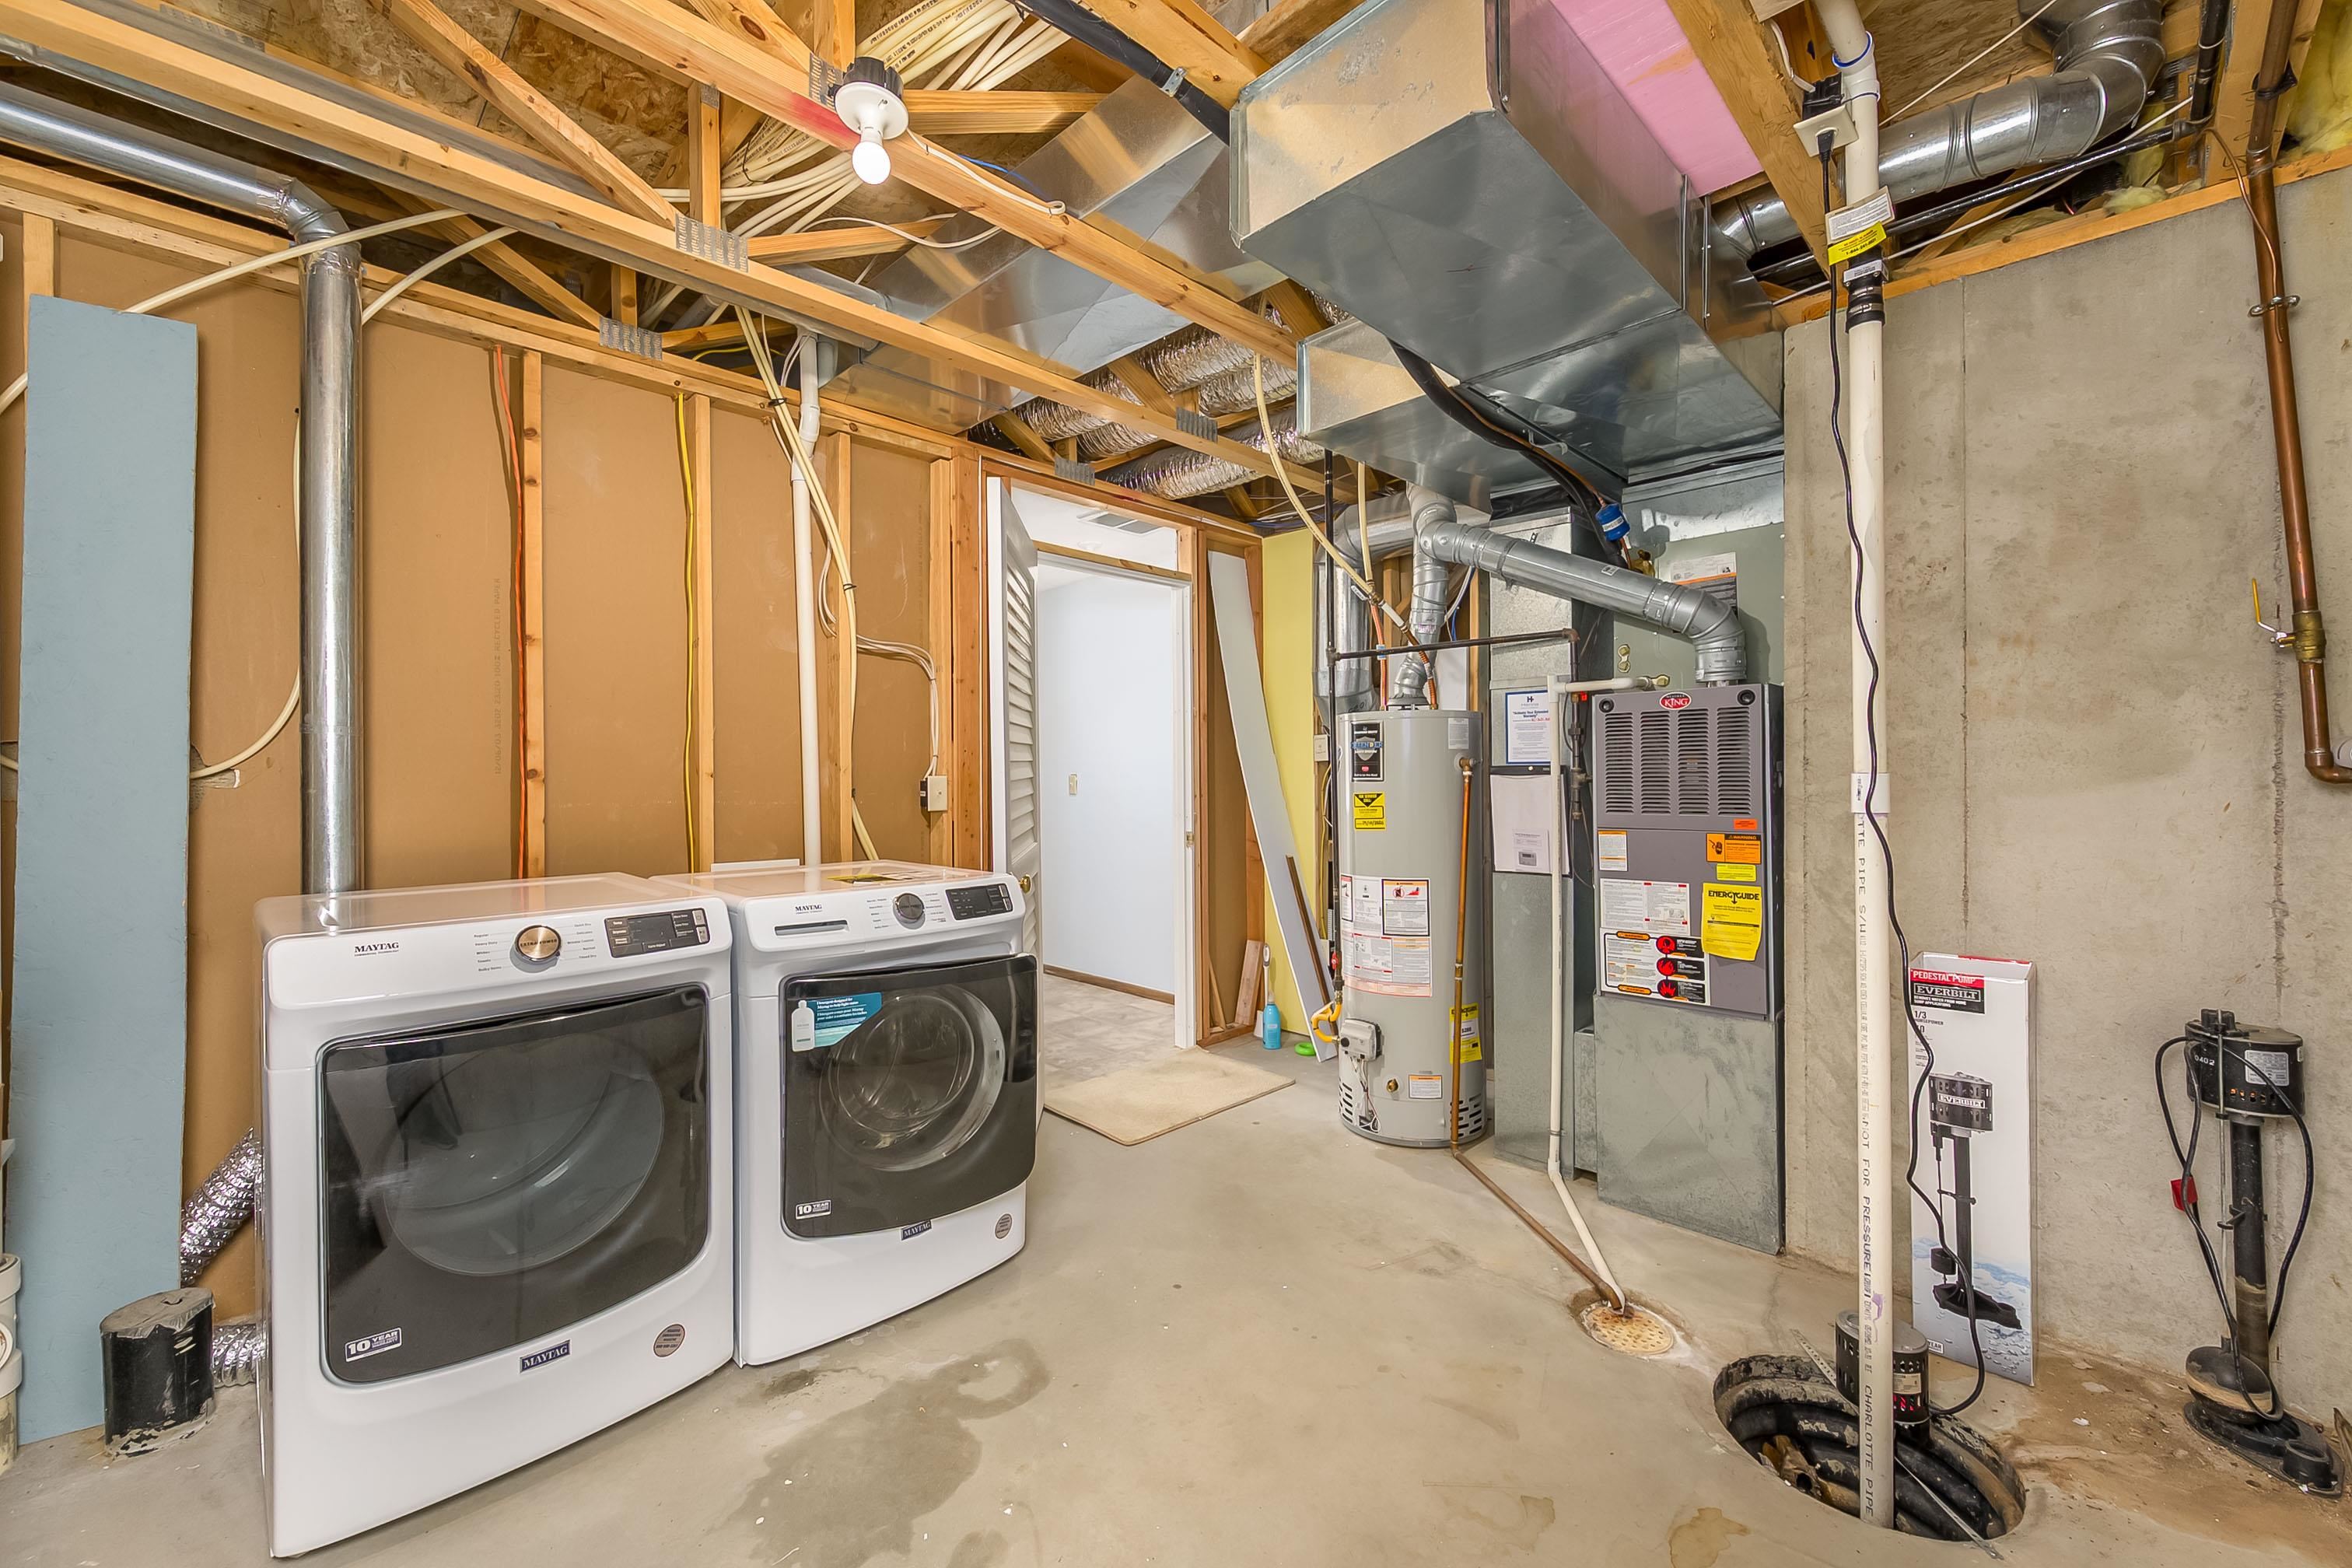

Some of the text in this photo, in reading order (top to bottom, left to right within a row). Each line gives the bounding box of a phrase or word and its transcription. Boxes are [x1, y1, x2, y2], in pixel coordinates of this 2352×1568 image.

[1664, 698, 1689, 708] KING
[1708, 891, 1759, 901] ENERGYGUIDE
[354, 942, 399, 953] MAYTAG
[1913, 971, 1951, 982] PEDESTAL
[1916, 985, 1977, 999] EVERBILT
[2194, 1055, 2215, 1066] 0402
[1940, 1094, 1983, 1107] EVERBILT
[798, 1206, 812, 1214] 10
[904, 1221, 930, 1237] MAYTAG
[348, 1339, 371, 1355] 10
[372, 1331, 398, 1342] YEAR
[523, 1346, 567, 1369] MAYTAG
[1864, 1385, 1873, 1470] CHARLOTTE
